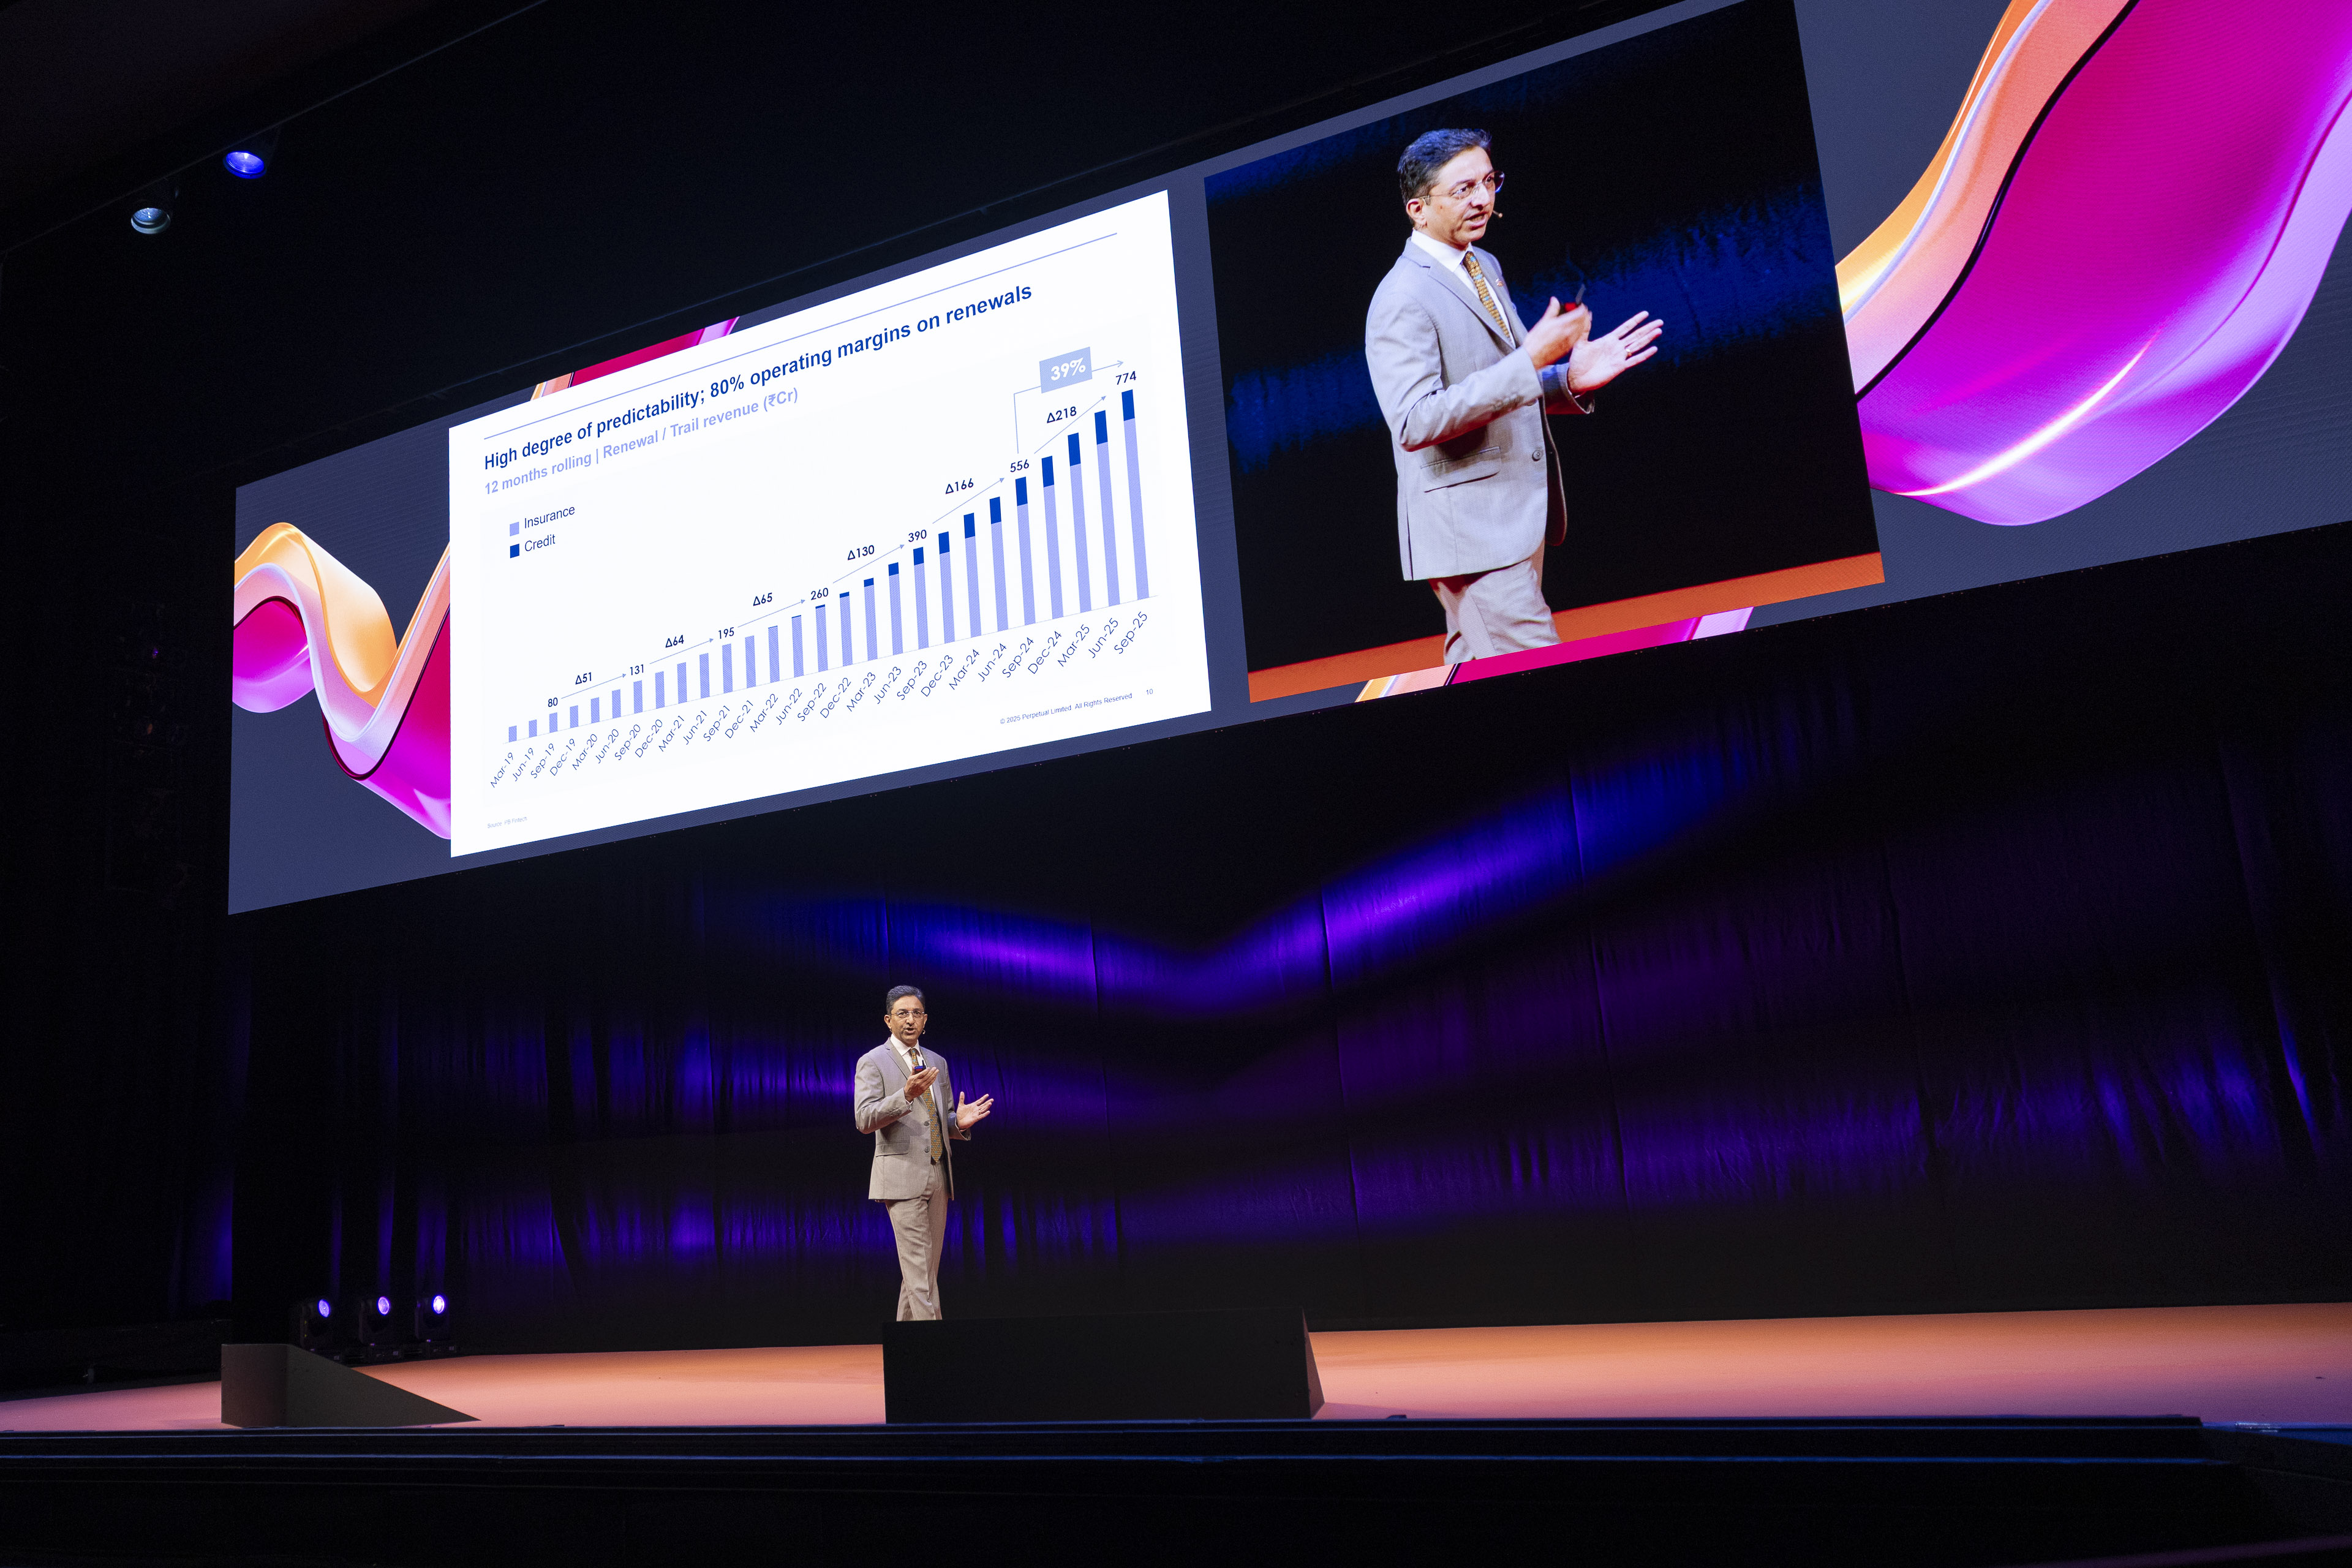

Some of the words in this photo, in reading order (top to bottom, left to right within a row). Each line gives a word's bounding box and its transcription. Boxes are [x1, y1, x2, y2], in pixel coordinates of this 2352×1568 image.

[485, 447, 518, 470] High
[522, 432, 573, 457] degree
[577, 422, 593, 440] of
[597, 390, 704, 438] predictability;
[710, 374, 745, 398] 80%
[750, 350, 832, 386] operating
[837, 325, 911, 358] margins
[917, 315, 940, 333] on
[946, 285, 1032, 324] renewals
[1050, 357, 1086, 381] 39%
[1115, 370, 1137, 385] 774
[1046, 405, 1077, 424] Δ218
[484, 480, 499, 495] 12
[502, 467, 548, 490] months
[552, 453, 592, 475] rolling
[603, 430, 658, 459] Renewal
[670, 418, 699, 437] Trail
[703, 403, 759, 428] revenue
[763, 387, 798, 412] (₹Cr)
[1009, 459, 1030, 473] 556
[945, 477, 974, 495] Δ166
[524, 506, 575, 529] Insurance
[908, 529, 927, 543] 390
[524, 533, 556, 552] Credit
[847, 544, 875, 561] Δ130
[752, 592, 773, 607] Δ65
[810, 587, 829, 601] 260
[665, 634, 685, 649] Δ64
[718, 627, 735, 639] 195
[1057, 624, 1090, 668] Mar-25
[1088, 617, 1118, 659] Jun-25
[1114, 611, 1148, 654] Sep-25
[629, 663, 644, 676] 131
[948, 649, 980, 690] Mar-24
[978, 643, 1007, 682] Jun-24
[1002, 636, 1034, 678] Sep-24
[1027, 630, 1062, 675] Dec-24
[575, 671, 592, 685] Δ51
[846, 671, 876, 712] Mar-23
[873, 666, 902, 705] Jun-23
[896, 660, 927, 701] Sep-23
[921, 655, 953, 698] Dec-23
[548, 696, 559, 708] 80
[749, 693, 778, 733] Mar-22
[775, 688, 802, 726] Jun-22
[797, 682, 827, 722] Sep-22
[820, 677, 852, 719] Dec-22
[1006, 715, 1021, 724] 2025
[1022, 709, 1050, 721] Perpetual
[1084, 698, 1102, 709] Rights
[658, 715, 685, 752] Mar-21
[683, 710, 707, 745] Jun-21
[703, 705, 730, 742] Sep-21
[725, 699, 754, 739] Dec-21
[571, 733, 598, 771] Mar-20
[595, 728, 619, 764] Jun-20
[614, 724, 641, 761] Sep-20
[635, 719, 663, 758] Dec-20
[490, 752, 514, 788] Mar-19
[512, 747, 534, 782] Jun-19
[530, 743, 554, 779] Sep-19
[549, 738, 576, 777] Dec-19
